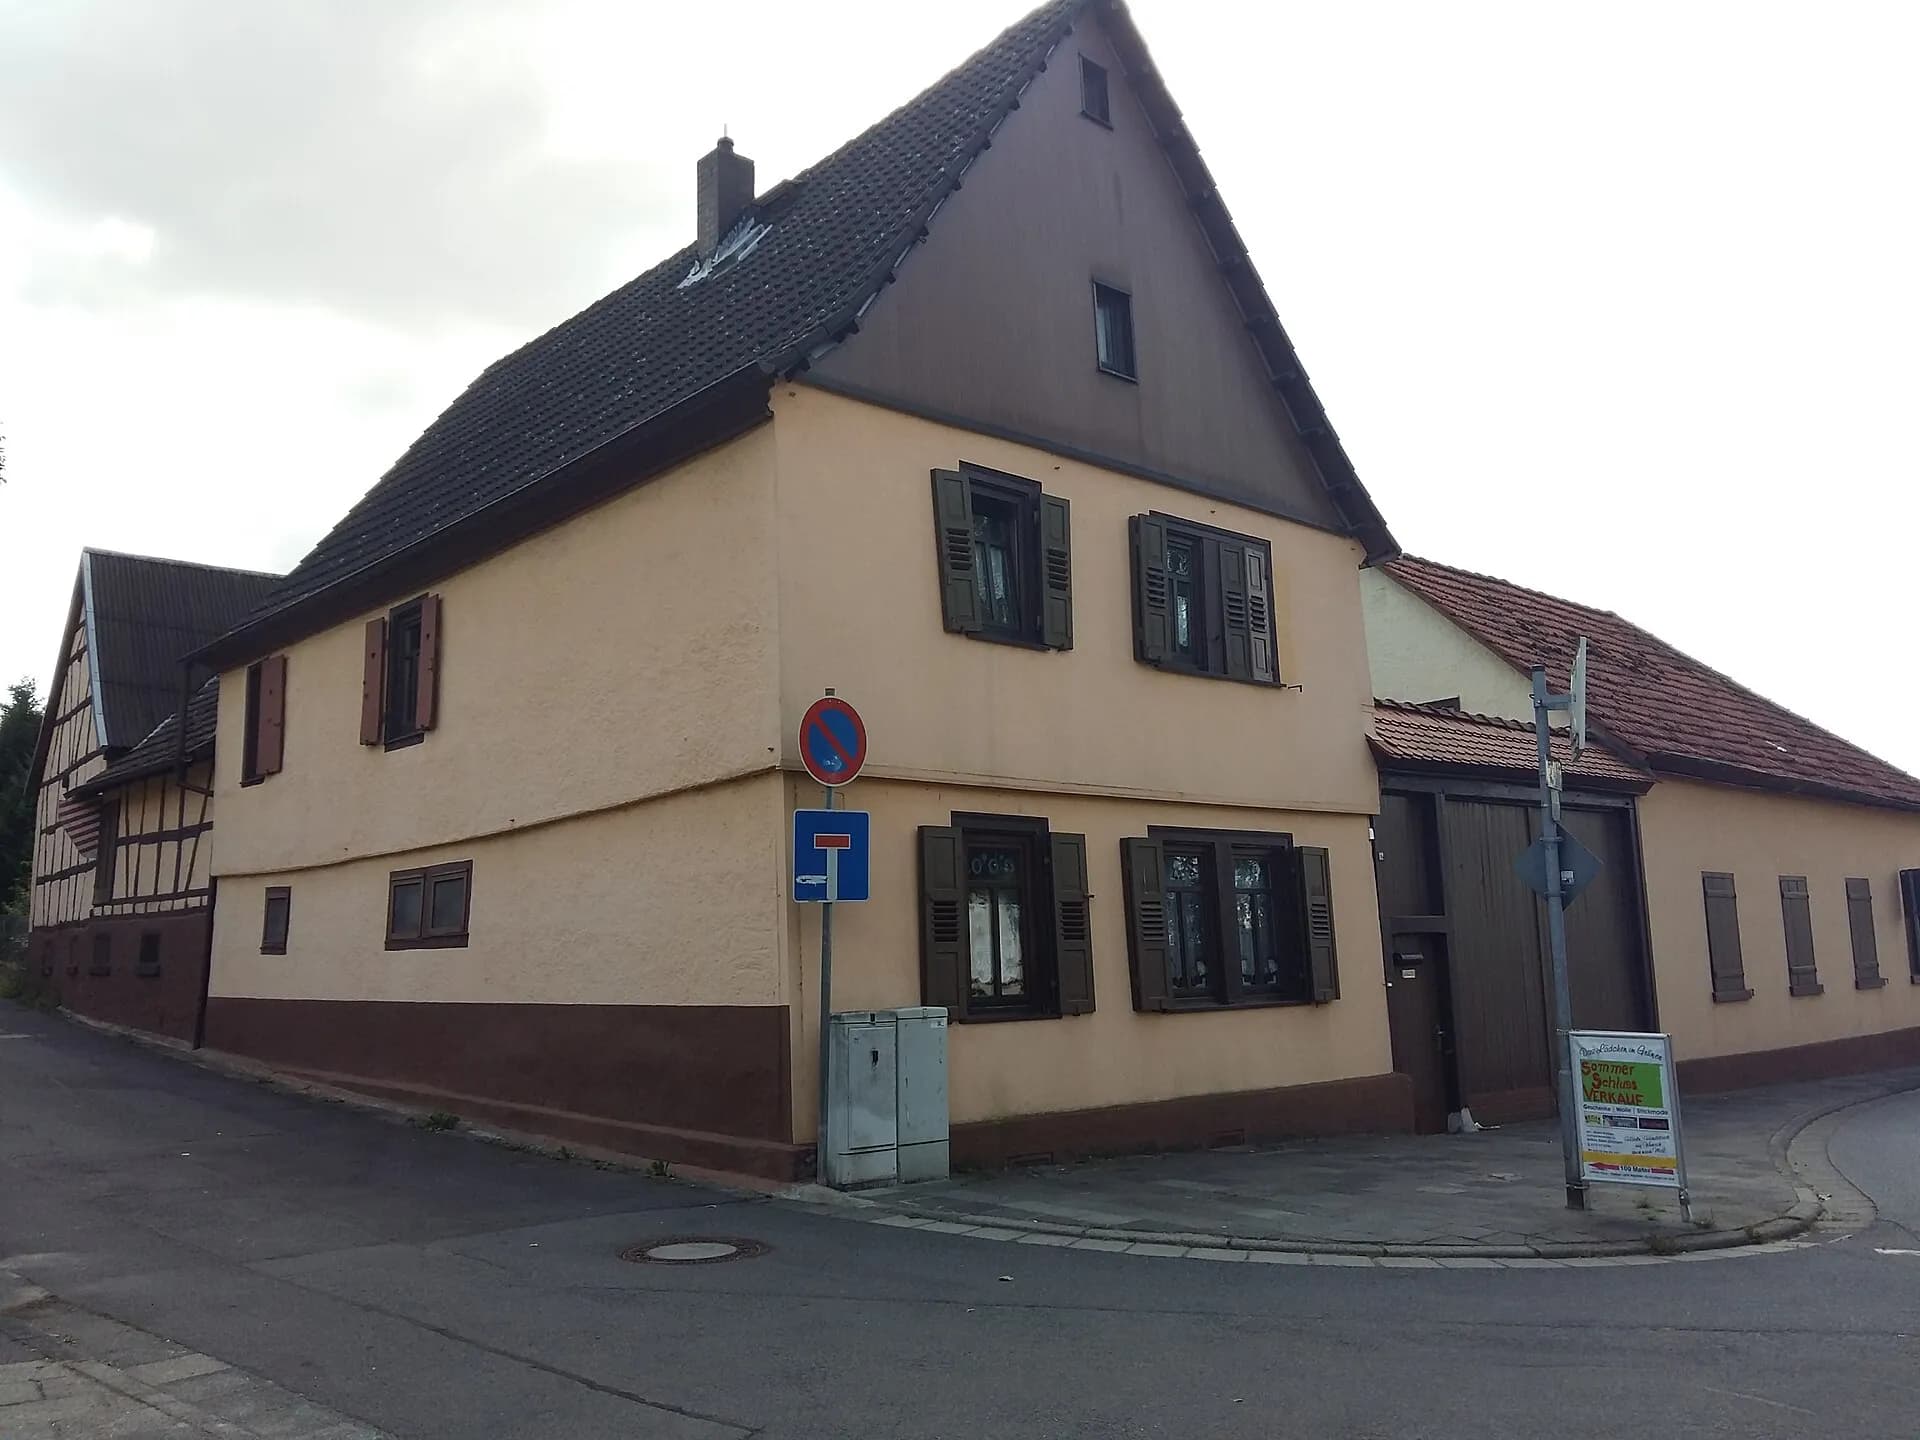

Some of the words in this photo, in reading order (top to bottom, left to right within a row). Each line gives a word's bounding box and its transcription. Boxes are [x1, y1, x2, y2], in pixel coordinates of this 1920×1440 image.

[1581, 1061, 1634, 1076] Sommer
[1592, 1072, 1638, 1090] Schluss
[1583, 1086, 1645, 1106] VERKAUF
[1620, 1164, 1632, 1172] 100
